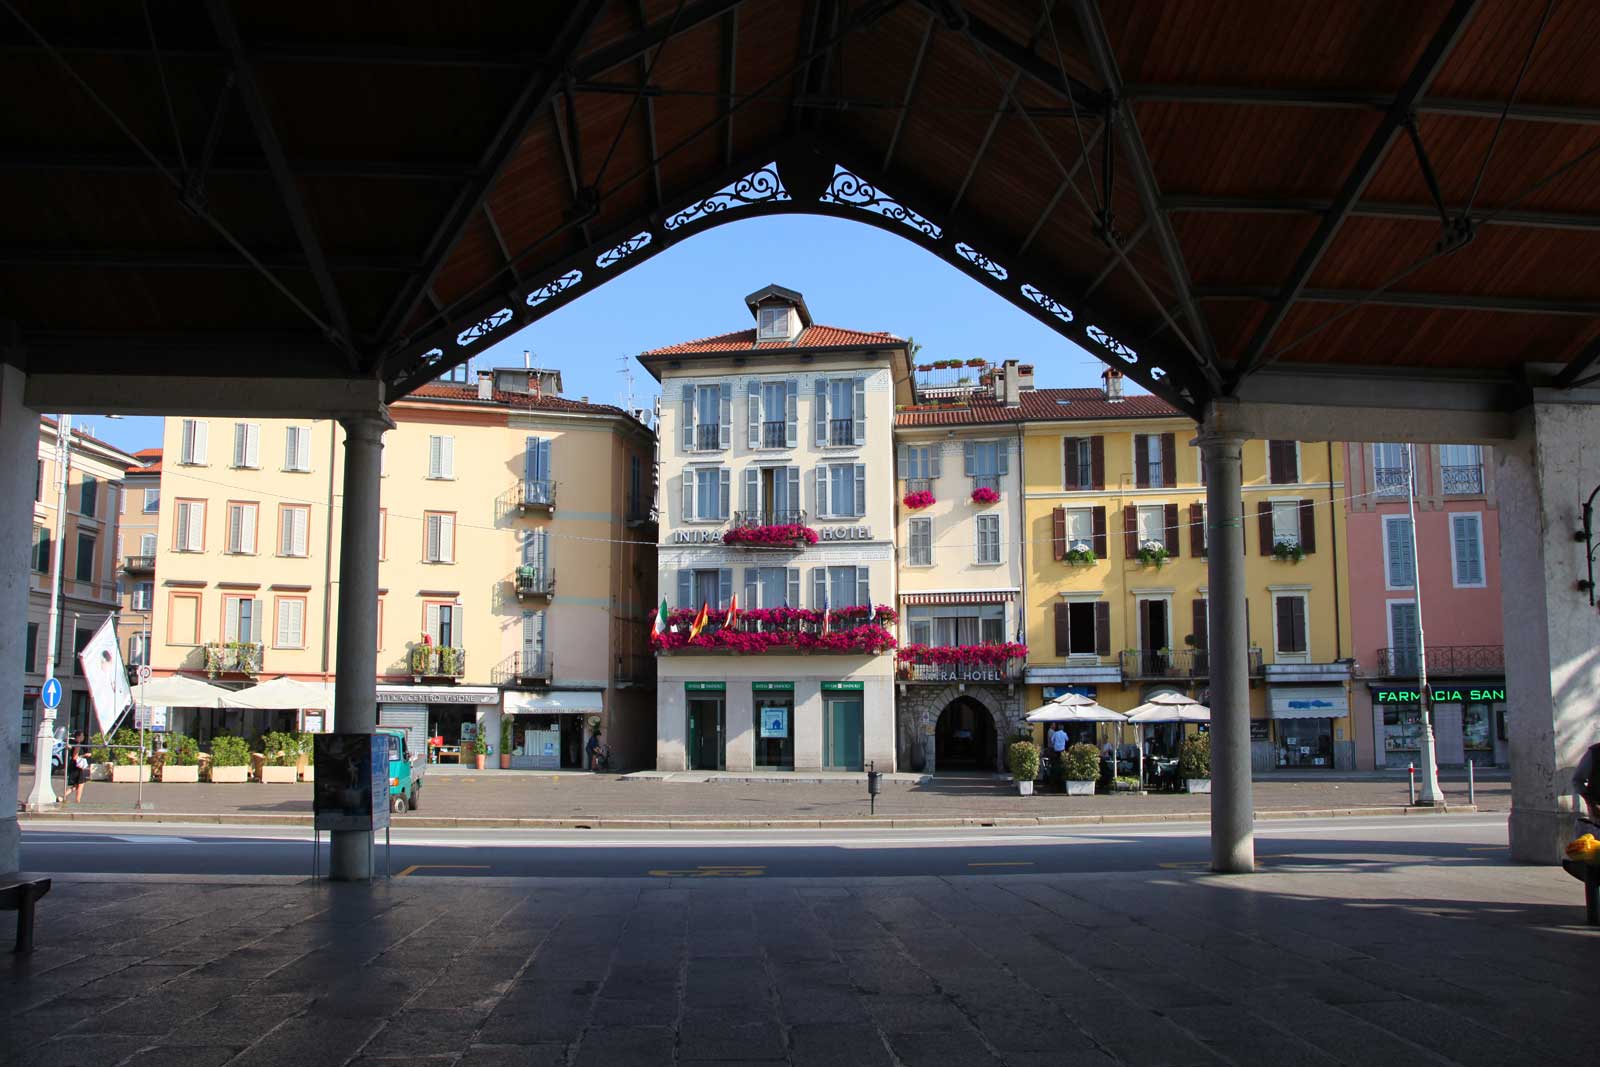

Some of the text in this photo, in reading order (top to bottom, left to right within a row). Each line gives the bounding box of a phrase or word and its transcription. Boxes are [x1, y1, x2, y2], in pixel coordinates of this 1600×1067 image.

[674, 525, 874, 543] INTRA HOTEL
[963, 671, 1001, 681] HOTEL
[407, 694, 441, 703] CENTRO
[445, 694, 475, 703] VISIONE
[1378, 689, 1504, 702] FARMCIA SAN
